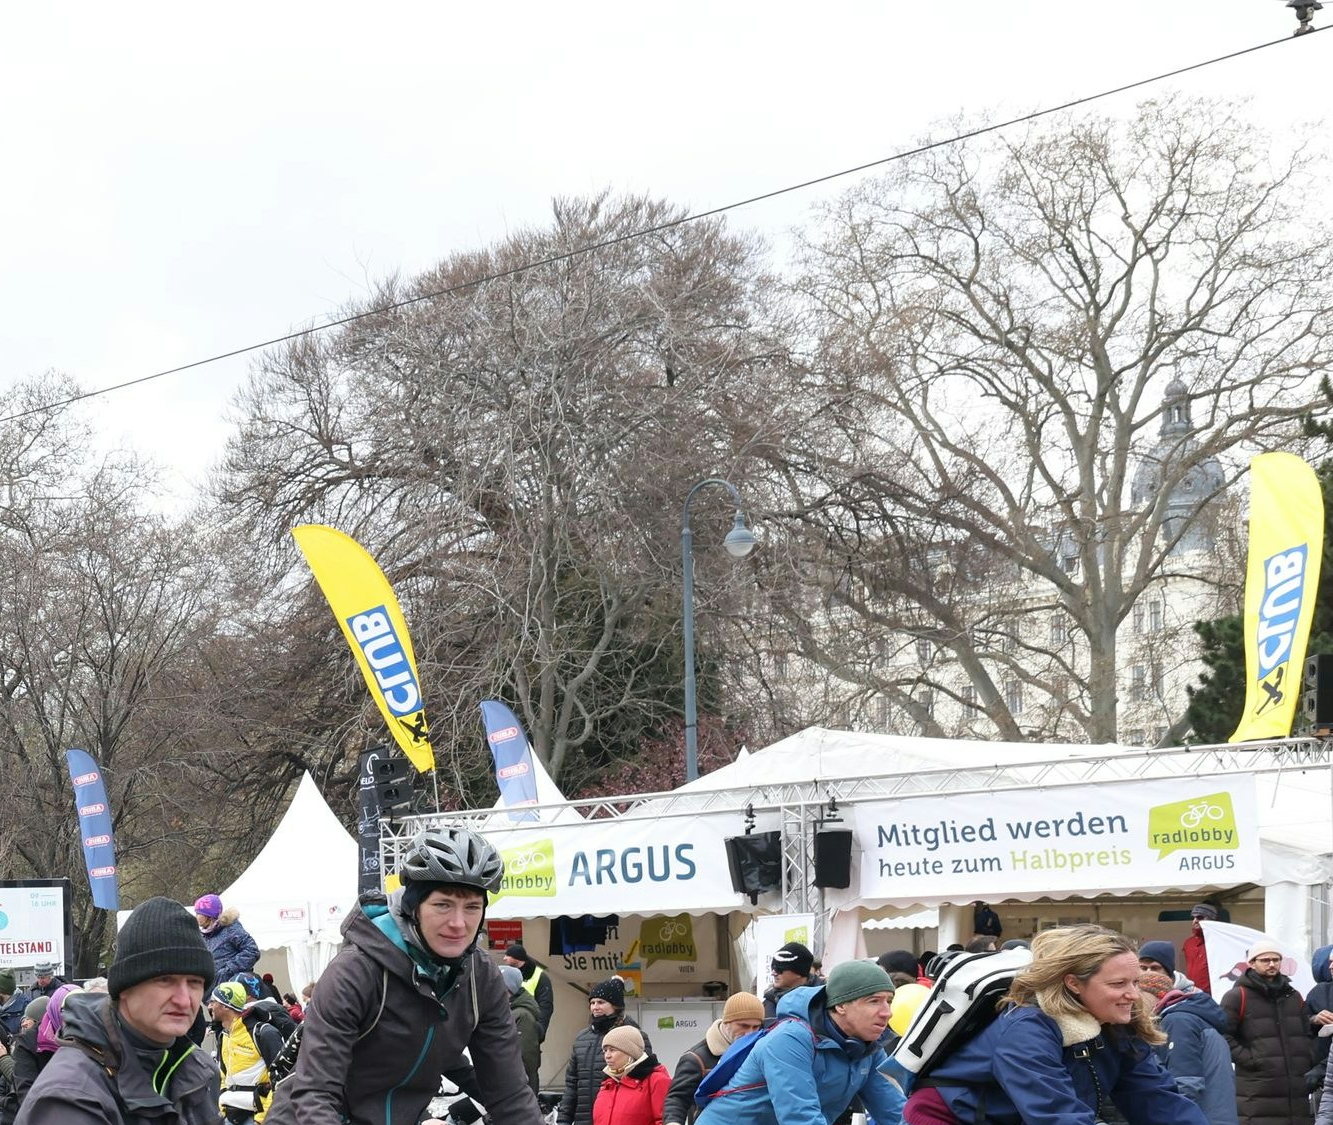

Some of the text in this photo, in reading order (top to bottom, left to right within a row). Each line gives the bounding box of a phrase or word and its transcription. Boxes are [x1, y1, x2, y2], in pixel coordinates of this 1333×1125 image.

[877, 811, 1128, 850] Mitglied werden
[1153, 826, 1234, 845] radlobby
[501, 844, 696, 892] dlobby ARGUS
[879, 846, 1131, 878] heute zum Halbpreis
[1178, 854, 1235, 872] ARGUS
[642, 941, 693, 957] radlobby
[564, 953, 588, 970] Sie
[676, 1020, 697, 1028] ARGUS
